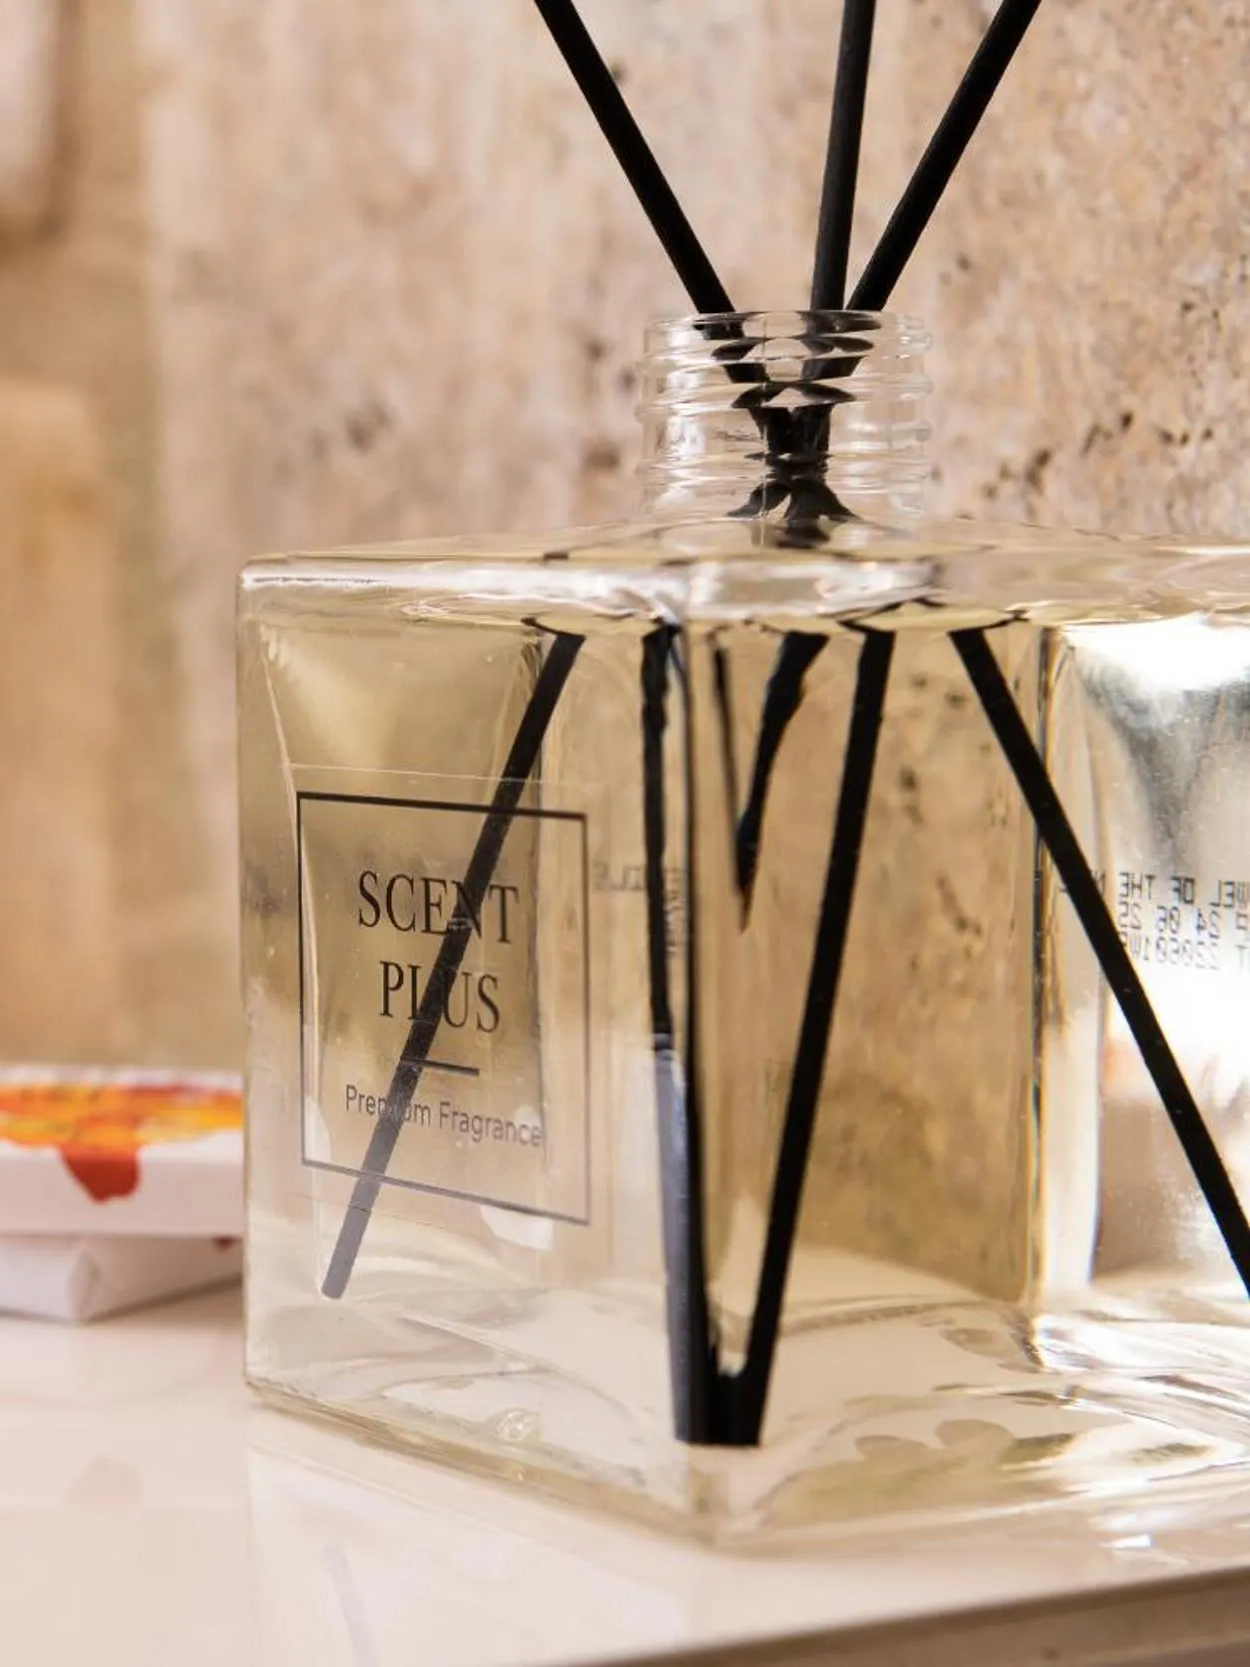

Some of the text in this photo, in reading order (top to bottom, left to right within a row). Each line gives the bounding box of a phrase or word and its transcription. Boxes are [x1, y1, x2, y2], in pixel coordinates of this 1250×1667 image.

[357, 869, 519, 944] SCENT
[378, 960, 501, 1034] PLUS
[345, 1084, 542, 1148] Premum Fragrance
